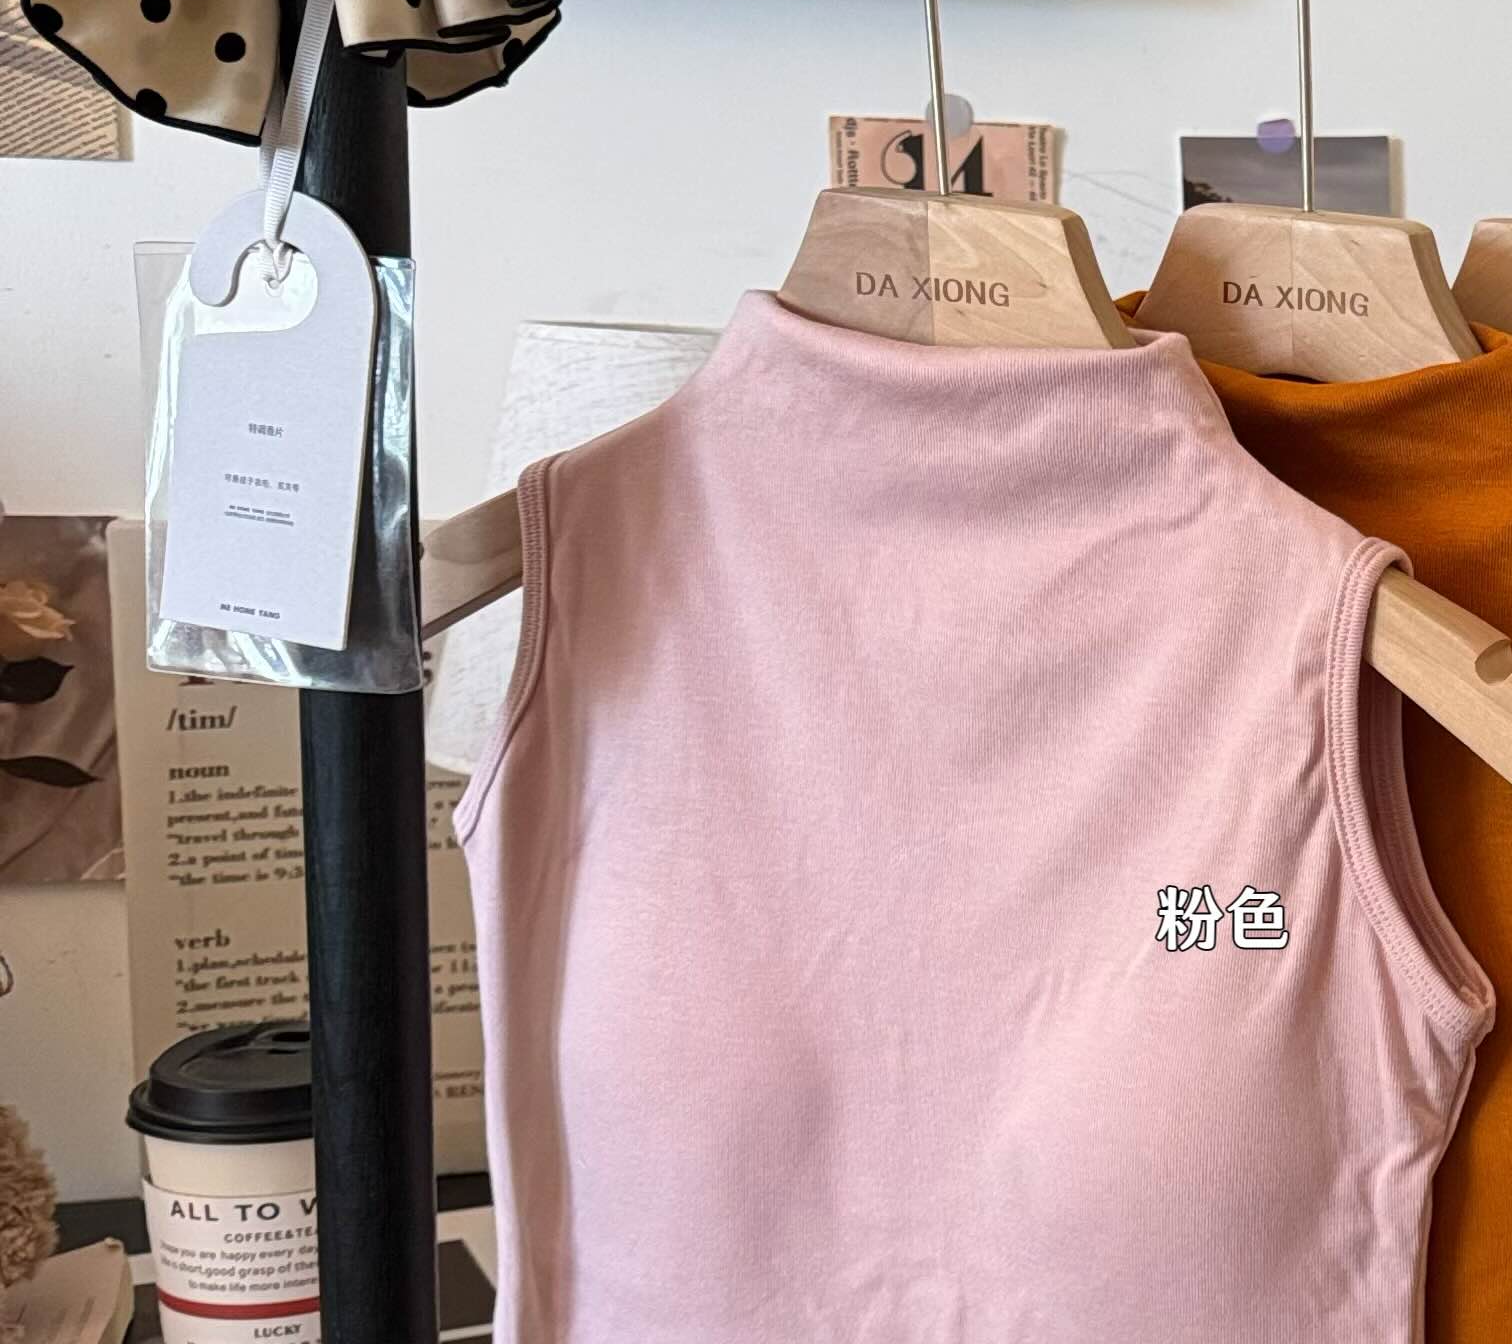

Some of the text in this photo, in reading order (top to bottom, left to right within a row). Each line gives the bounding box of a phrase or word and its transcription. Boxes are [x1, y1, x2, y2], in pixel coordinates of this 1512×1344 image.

[855, 271, 1011, 308] DA XIONG
[1222, 281, 1369, 316] DA XIONG
[166, 705, 237, 731] /tim/
[169, 765, 229, 780] noun
[174, 928, 230, 950] verb
[170, 1199, 219, 1222] ALL
[234, 1203, 280, 1222] TO
[224, 1226, 317, 1244] COFFEE&TE
[220, 1250, 258, 1262] happy
[254, 1323, 303, 1338] LUCKY
